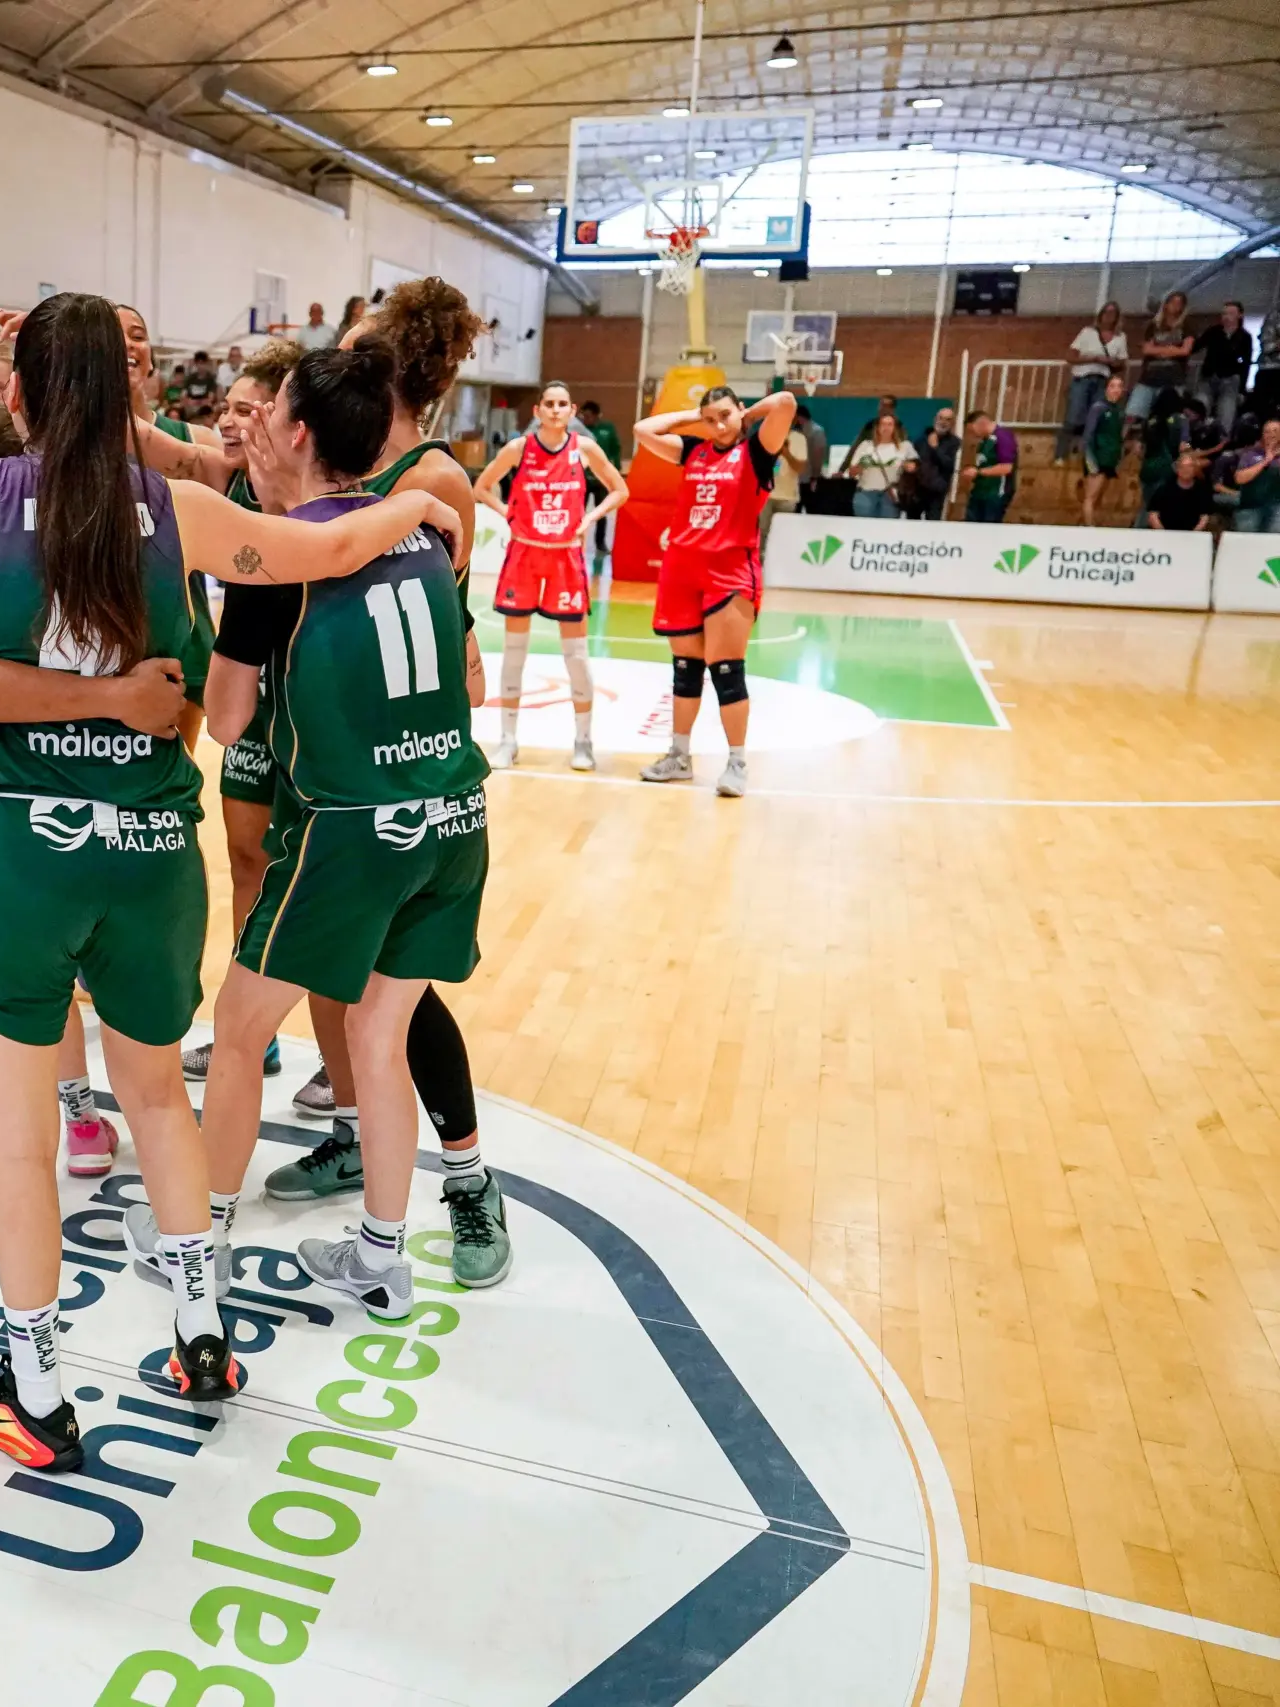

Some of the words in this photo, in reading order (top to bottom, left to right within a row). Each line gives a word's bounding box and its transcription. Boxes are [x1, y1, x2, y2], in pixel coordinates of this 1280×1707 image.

[542, 492, 563, 510] 24
[696, 484, 717, 503] 22
[851, 538, 963, 560] Fundación
[1049, 546, 1173, 566] Fundación
[850, 555, 929, 578] Unicaja
[1048, 564, 1135, 587] Unicaja
[558, 591, 583, 610] 24
[364, 578, 440, 699] 11
[224, 768, 260, 785] DENTAL
[446, 800, 468, 819] EL
[119, 811, 147, 830] EL
[148, 811, 184, 830] SOL
[105, 830, 186, 853] MÁLAGA
[181, 1249, 205, 1302] UNICAJA
[31, 1322, 57, 1374] UNICAJA
